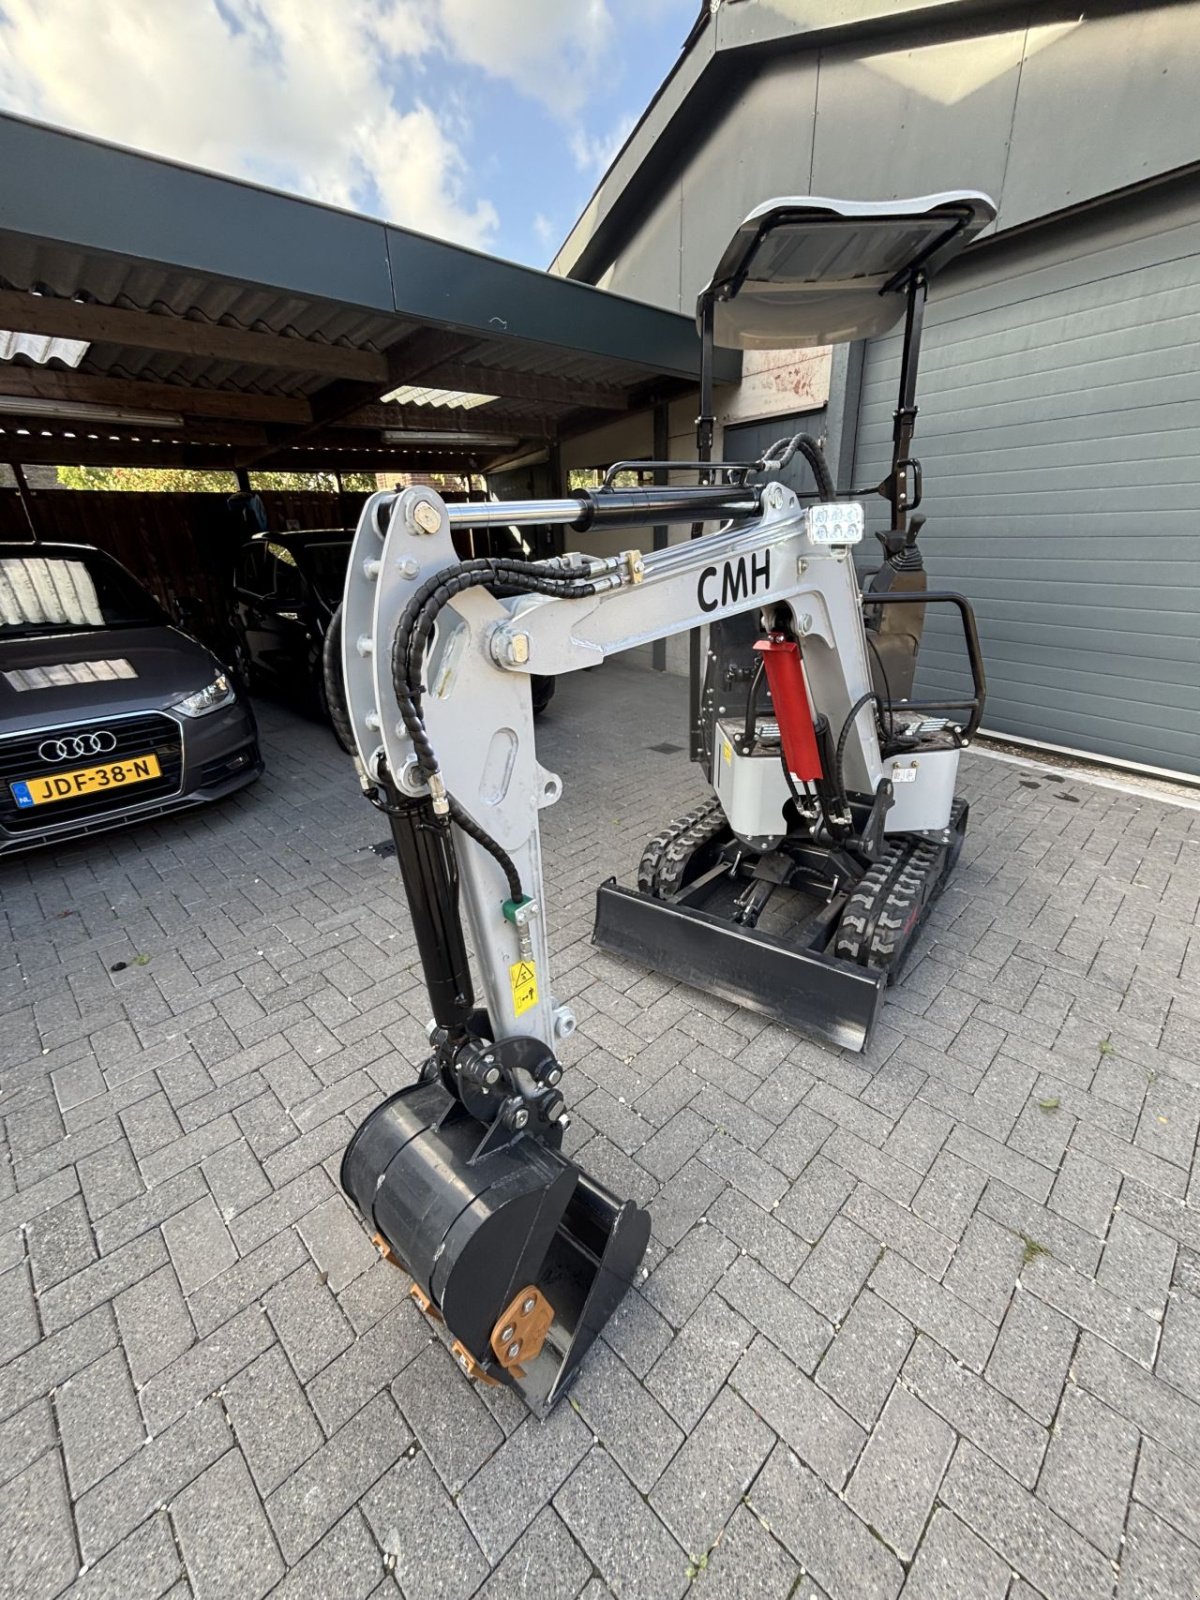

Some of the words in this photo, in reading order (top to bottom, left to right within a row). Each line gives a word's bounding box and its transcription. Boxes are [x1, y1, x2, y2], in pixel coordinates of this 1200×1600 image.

[697, 548, 770, 613] CMH
[41, 760, 151, 799] JDF-38-N
[19, 796, 32, 804] NL
